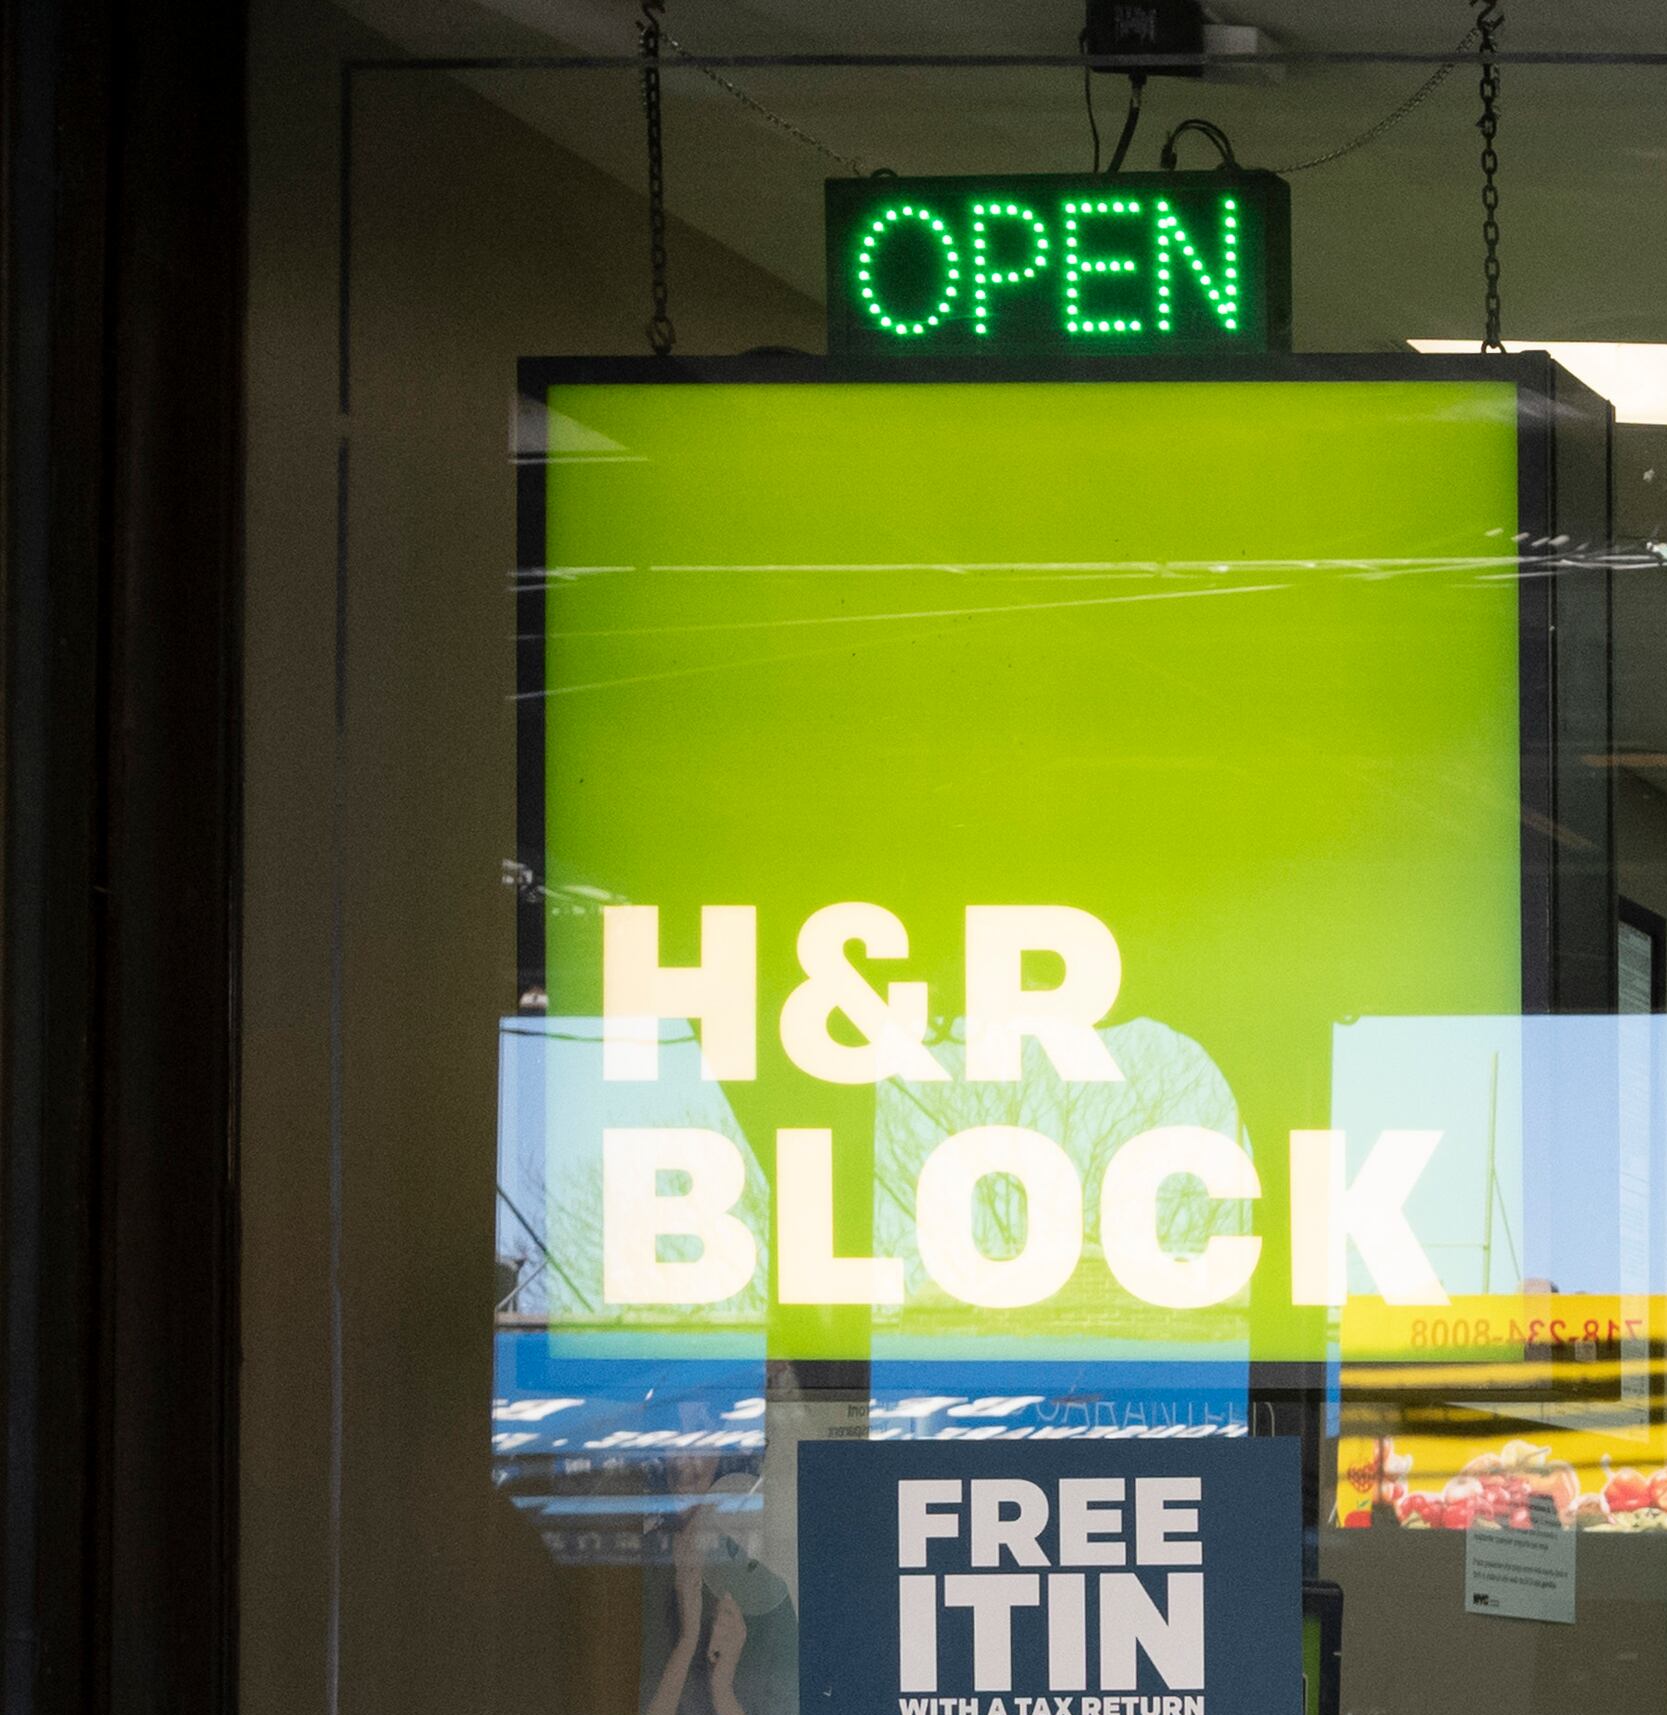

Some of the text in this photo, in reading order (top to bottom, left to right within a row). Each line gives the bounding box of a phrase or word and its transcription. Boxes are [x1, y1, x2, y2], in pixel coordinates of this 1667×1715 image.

[857, 197, 1240, 336] OPEN
[603, 901, 1124, 1084] H&R
[603, 1124, 1452, 1309] BLOCK
[898, 1477, 1203, 1568] FREE
[899, 1572, 1205, 1692] ITIN
